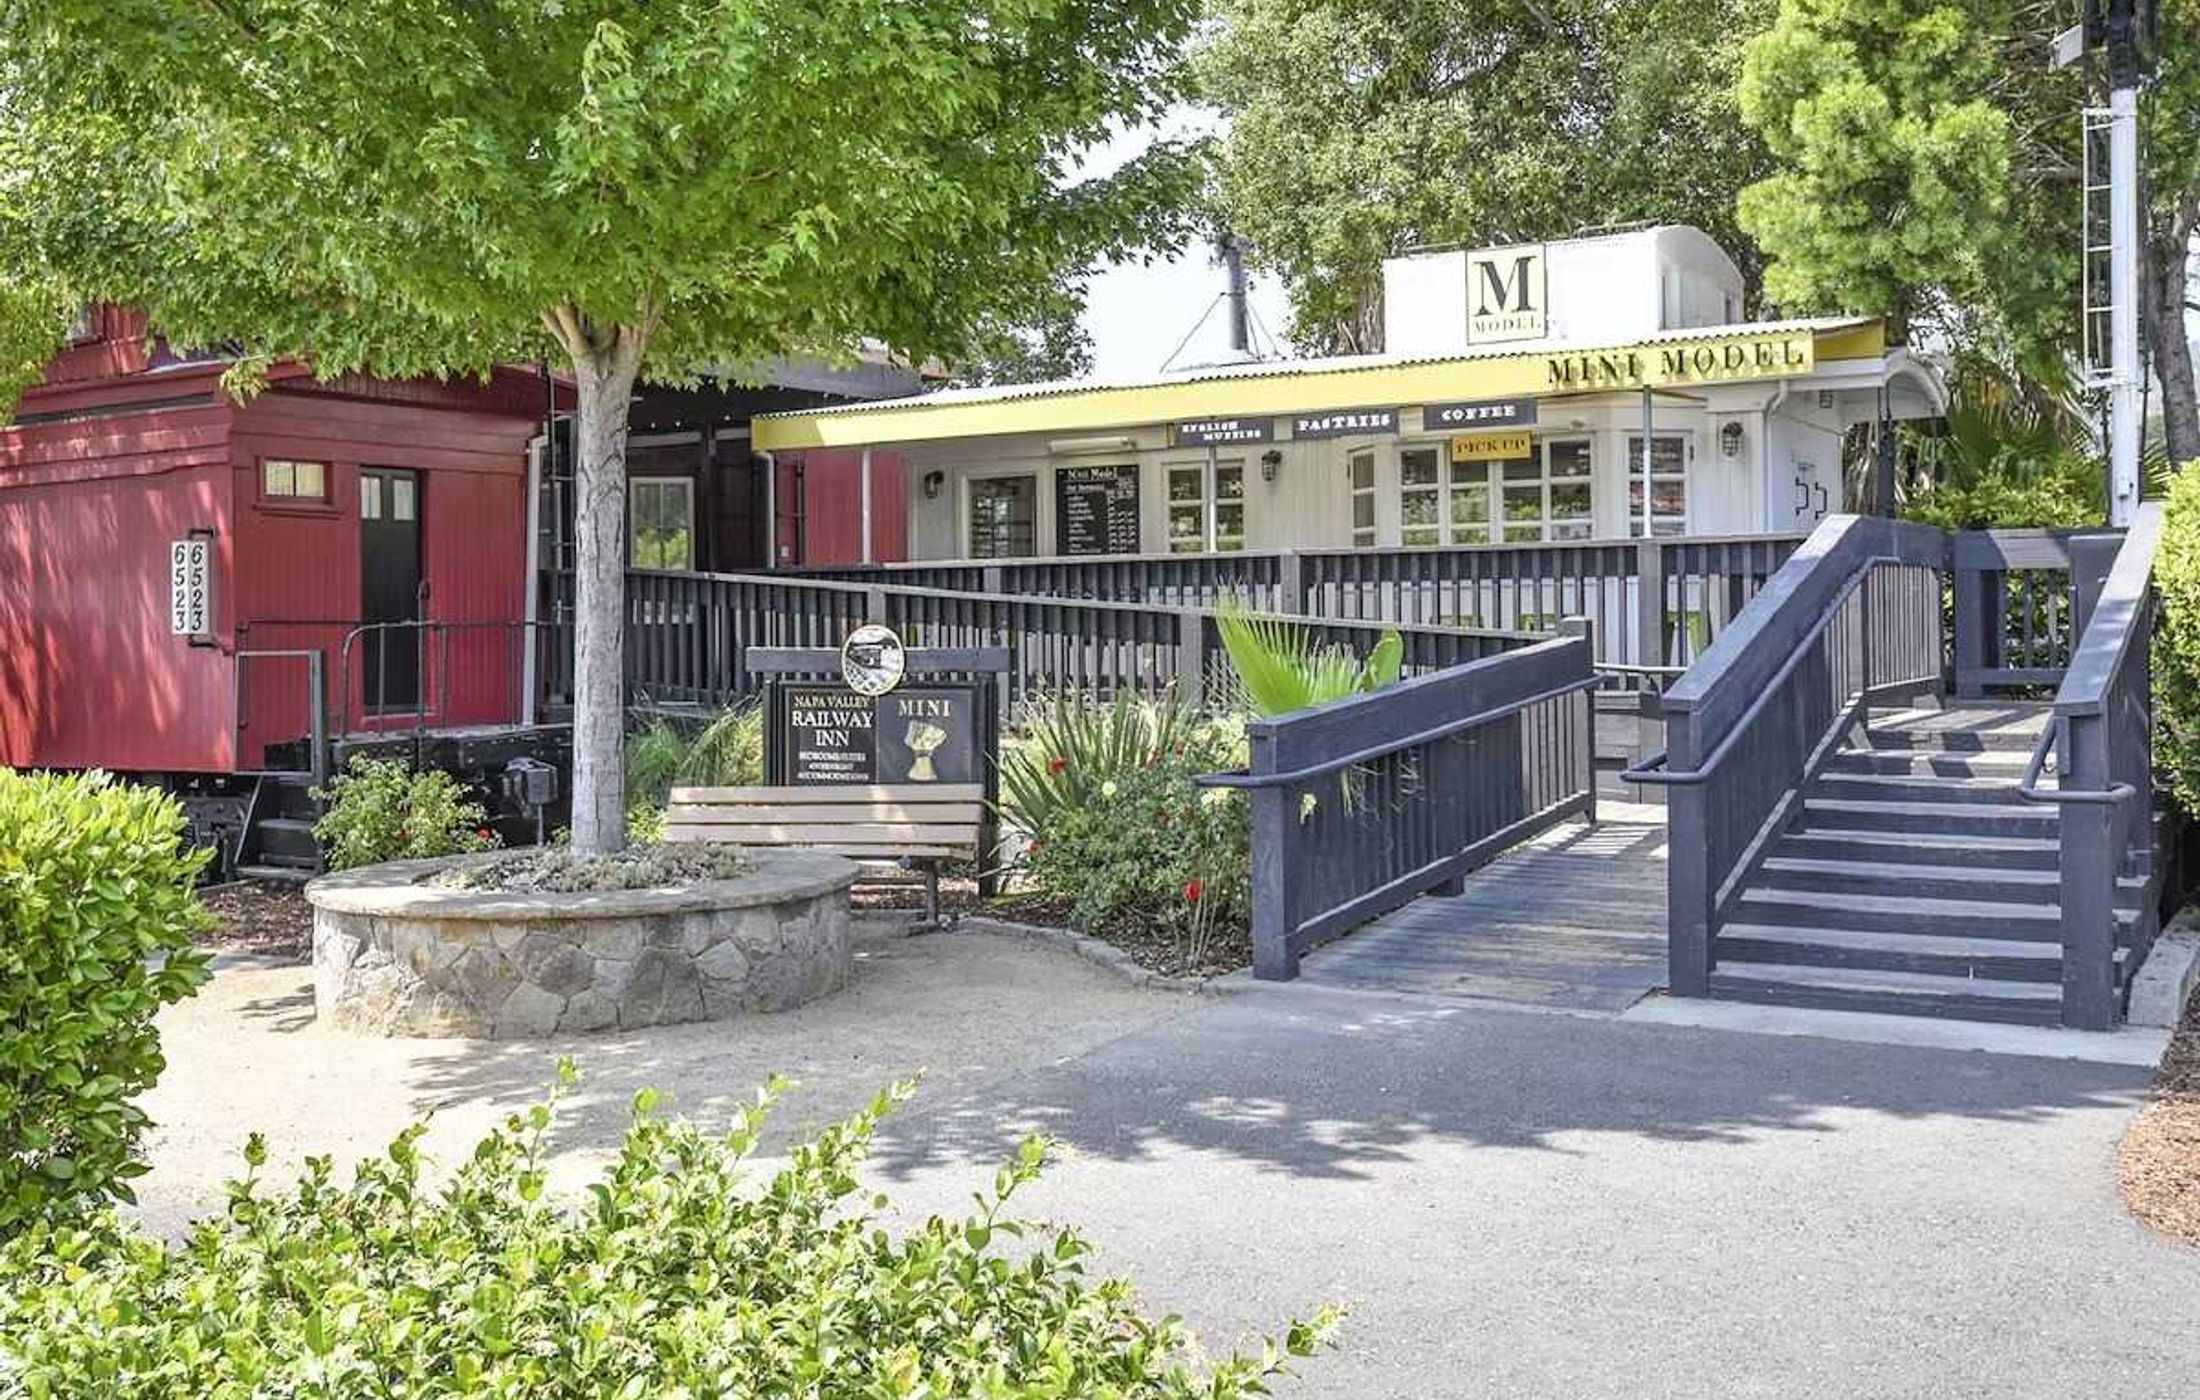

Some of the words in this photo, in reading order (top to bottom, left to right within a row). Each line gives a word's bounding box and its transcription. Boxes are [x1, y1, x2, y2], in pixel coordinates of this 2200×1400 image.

[1473, 255, 1538, 317] M
[1474, 315, 1542, 334] MODEL
[1548, 352, 1637, 383] MINI
[1662, 340, 1804, 376] MODEL
[1441, 405, 1517, 421] COFFEE
[1298, 413, 1392, 432] PASTRIES
[1456, 440, 1498, 454] PICK
[1502, 438, 1526, 451] UP
[174, 544, 186, 631] 6523
[191, 544, 204, 631] 6523
[794, 695, 827, 708] NAPA
[828, 695, 870, 708] VALLEY
[899, 699, 951, 717] MINI
[792, 710, 873, 728] RAILWAY
[815, 730, 850, 746] INN
